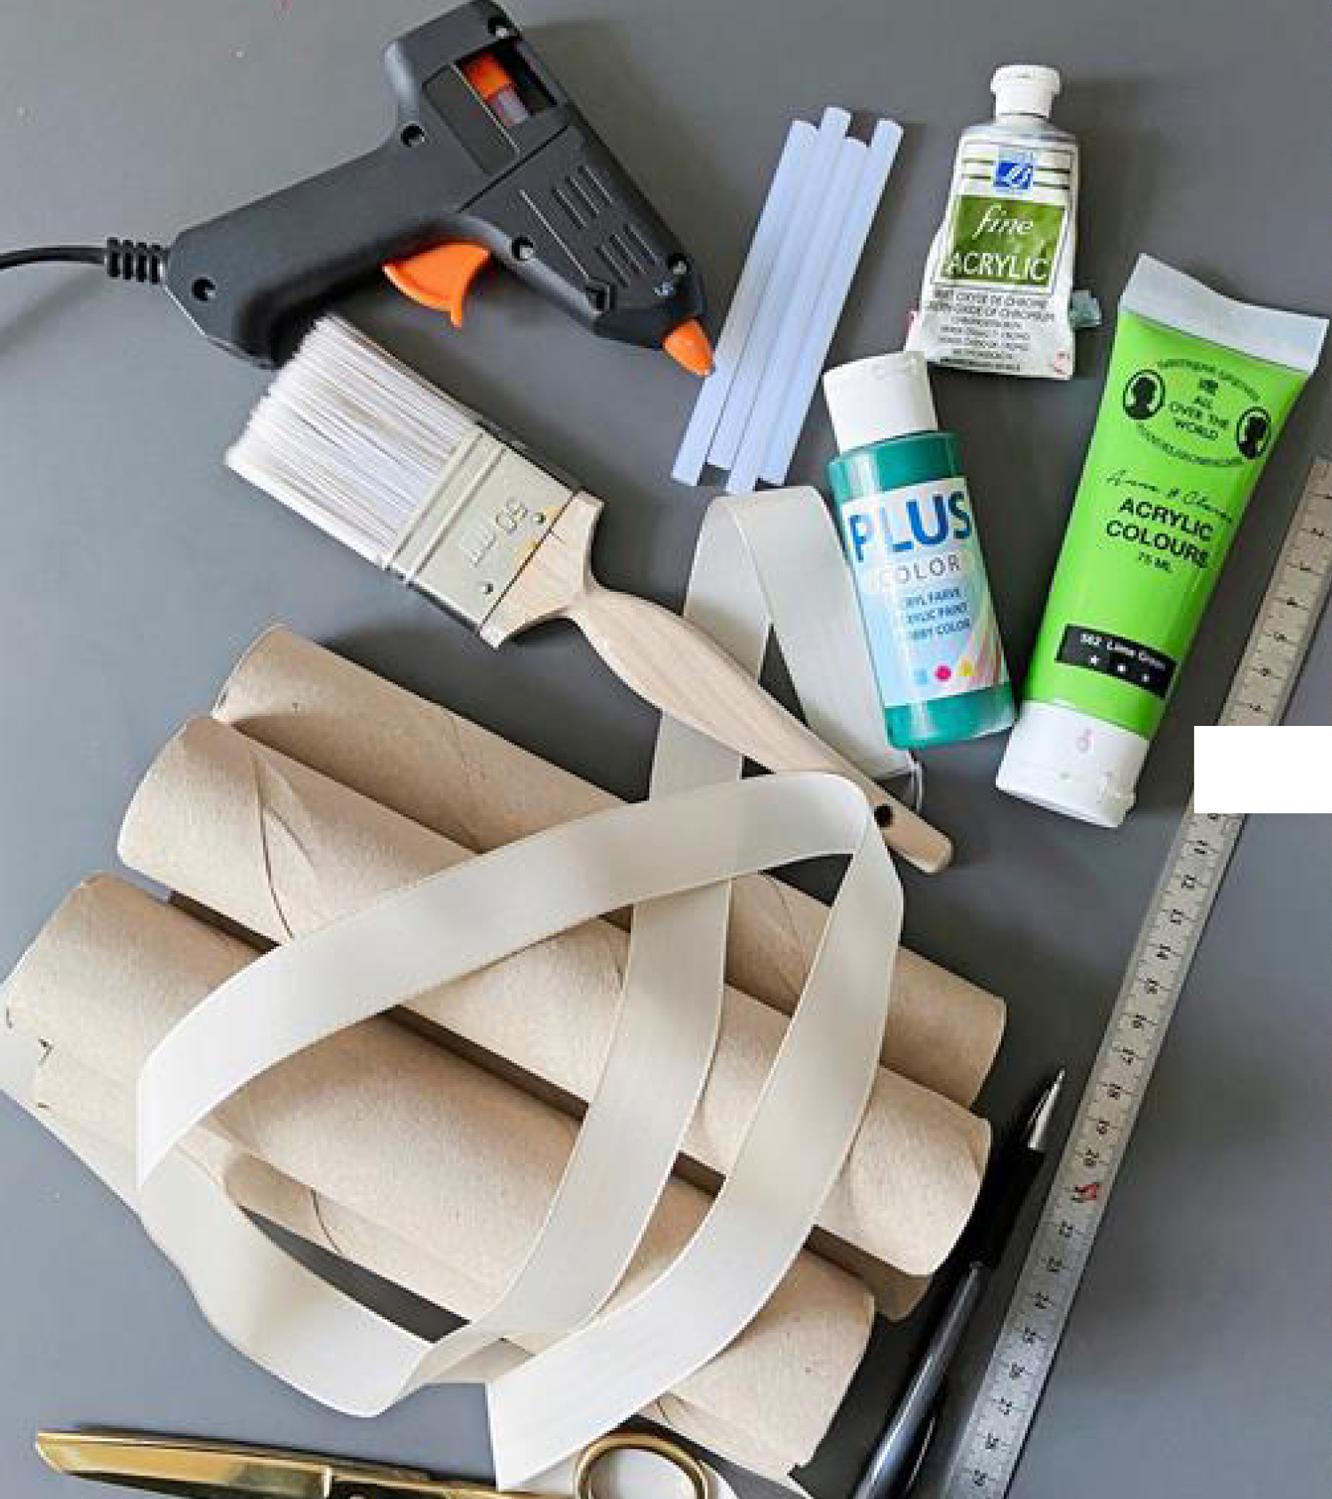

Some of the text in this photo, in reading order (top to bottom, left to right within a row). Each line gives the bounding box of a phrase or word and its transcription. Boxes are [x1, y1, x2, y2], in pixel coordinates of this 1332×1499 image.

[972, 203, 1034, 240] fine
[944, 250, 1049, 281] ACRYLIC
[1168, 401, 1203, 419] OVER
[1174, 419, 1219, 441] WORLD
[847, 490, 971, 564] PLUS
[1119, 497, 1214, 542] ACRYLIC
[1106, 519, 1209, 569] COLOURS
